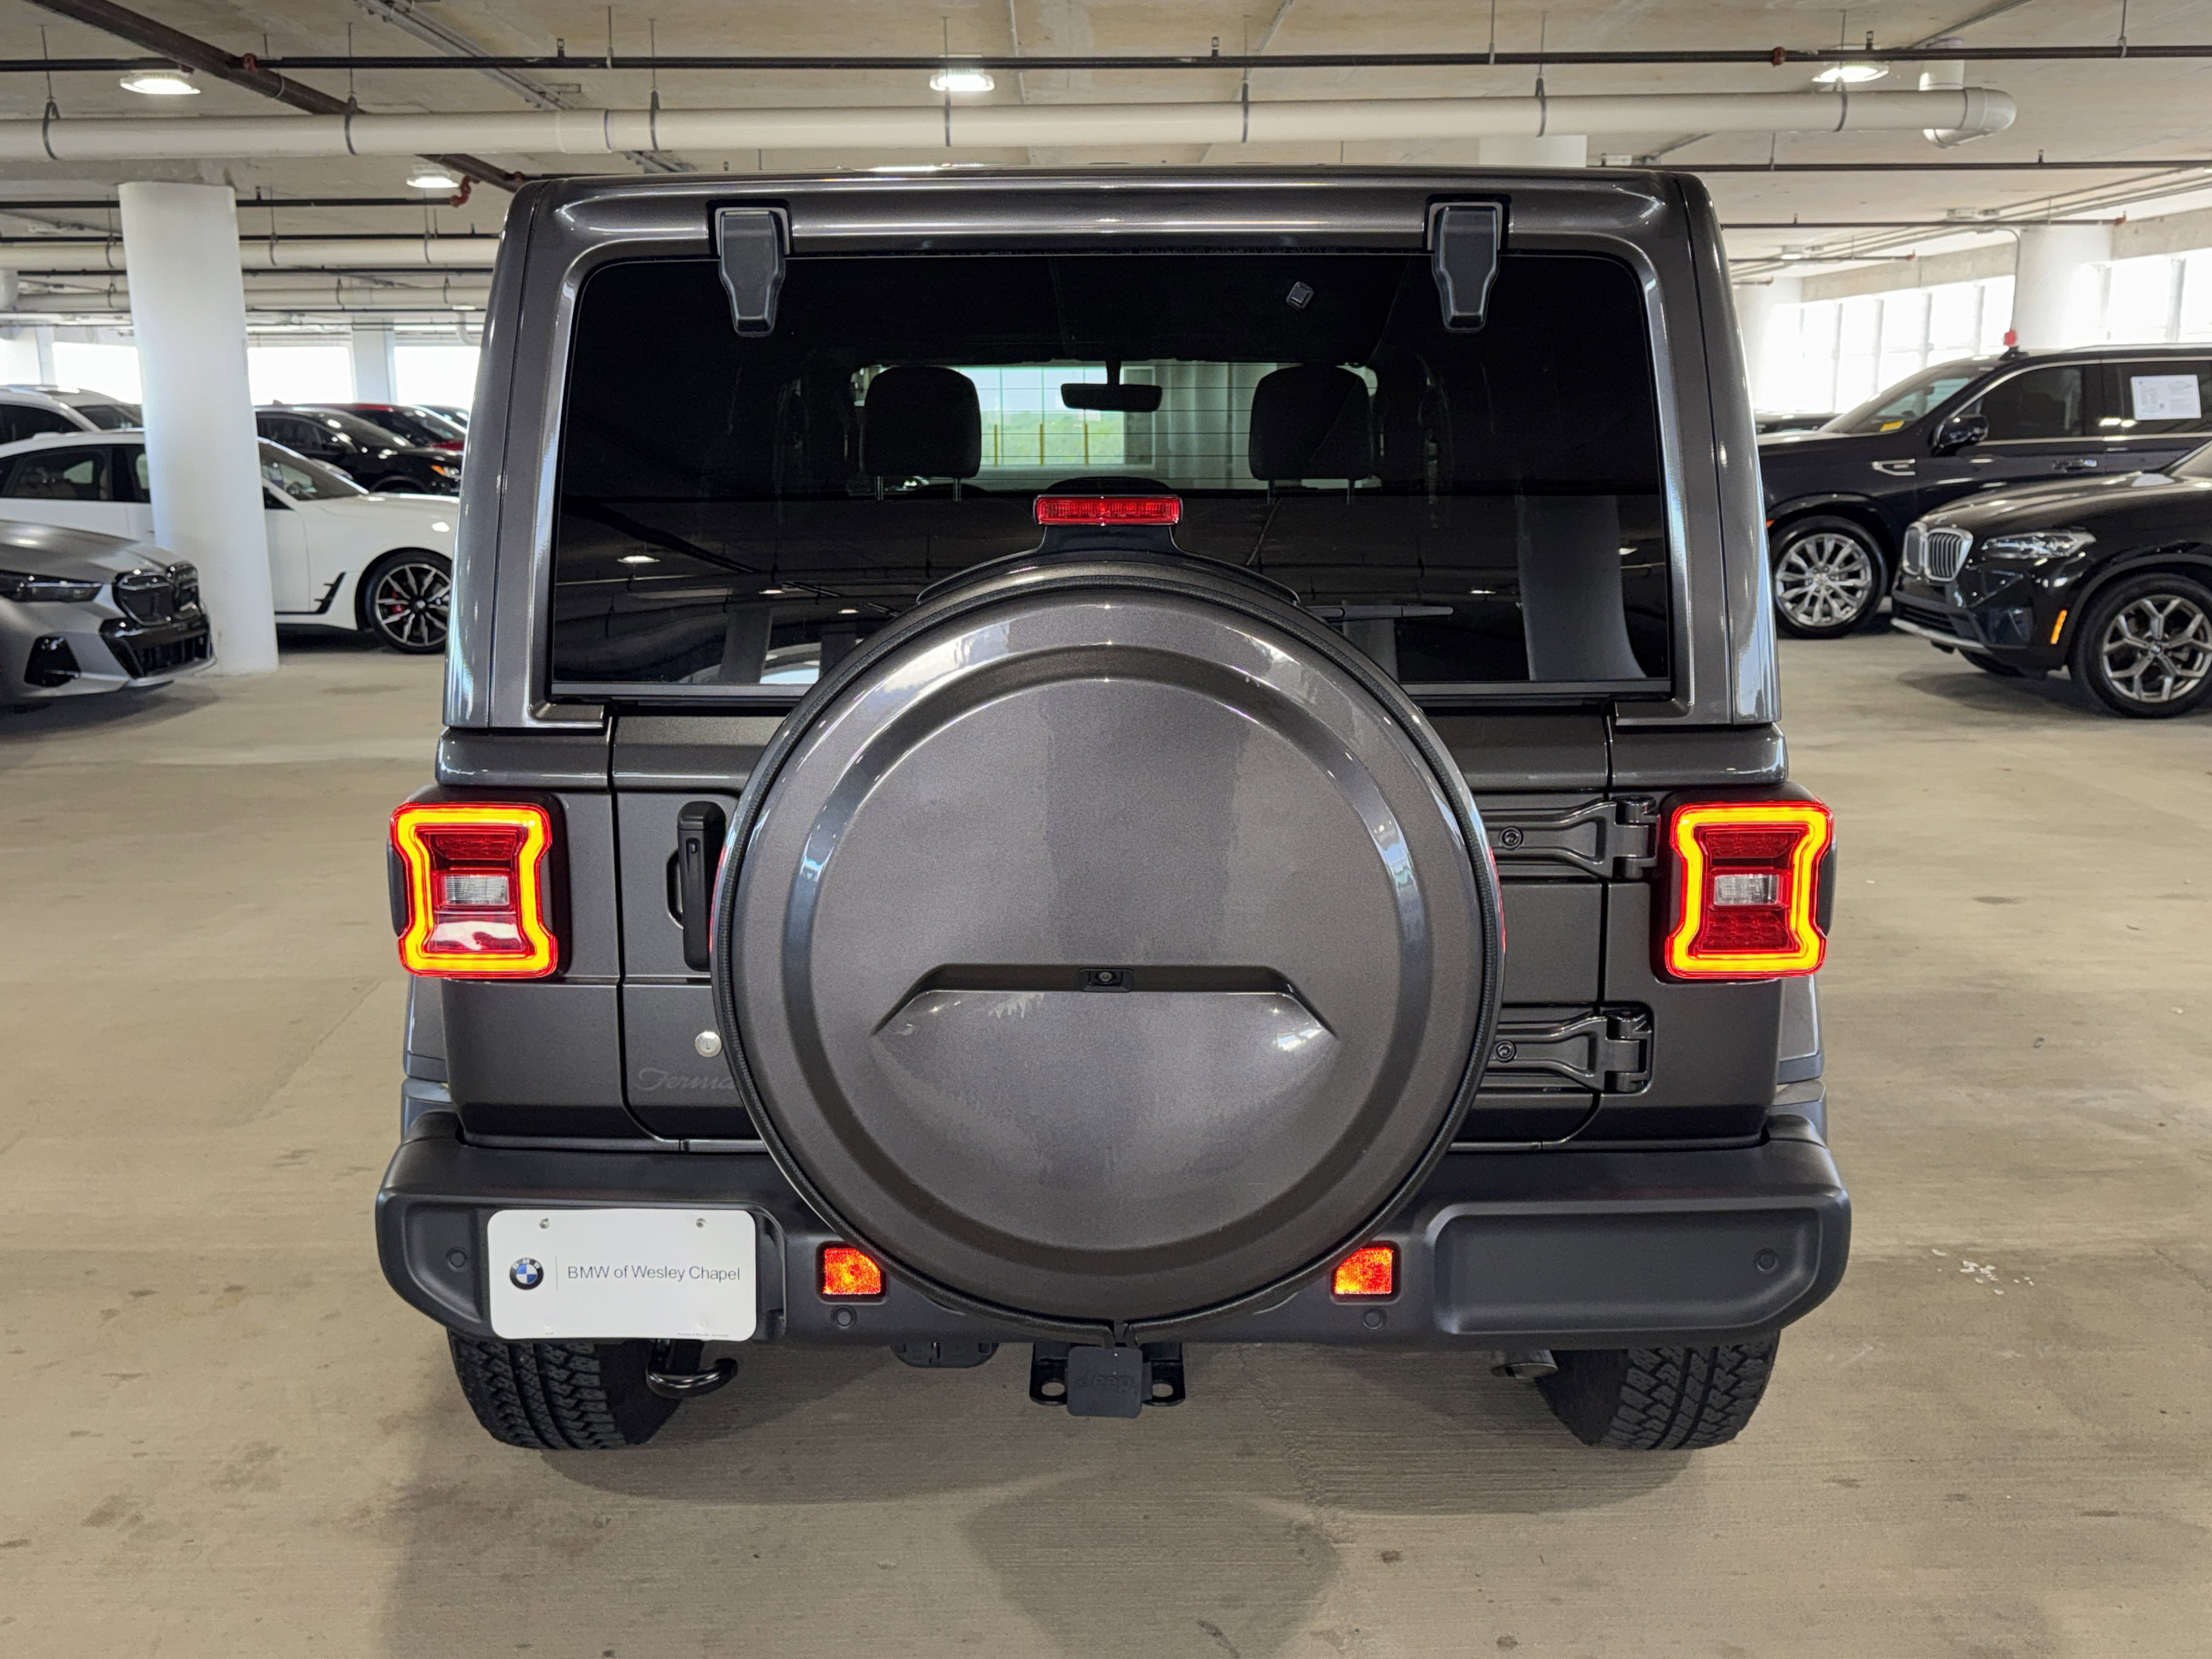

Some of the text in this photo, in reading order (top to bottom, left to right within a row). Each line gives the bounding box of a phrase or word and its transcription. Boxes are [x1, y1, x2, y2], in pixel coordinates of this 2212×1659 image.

[567, 1265, 740, 1283] BMW of Wesley Chapel
[1075, 1370, 1133, 1394] Jeep
